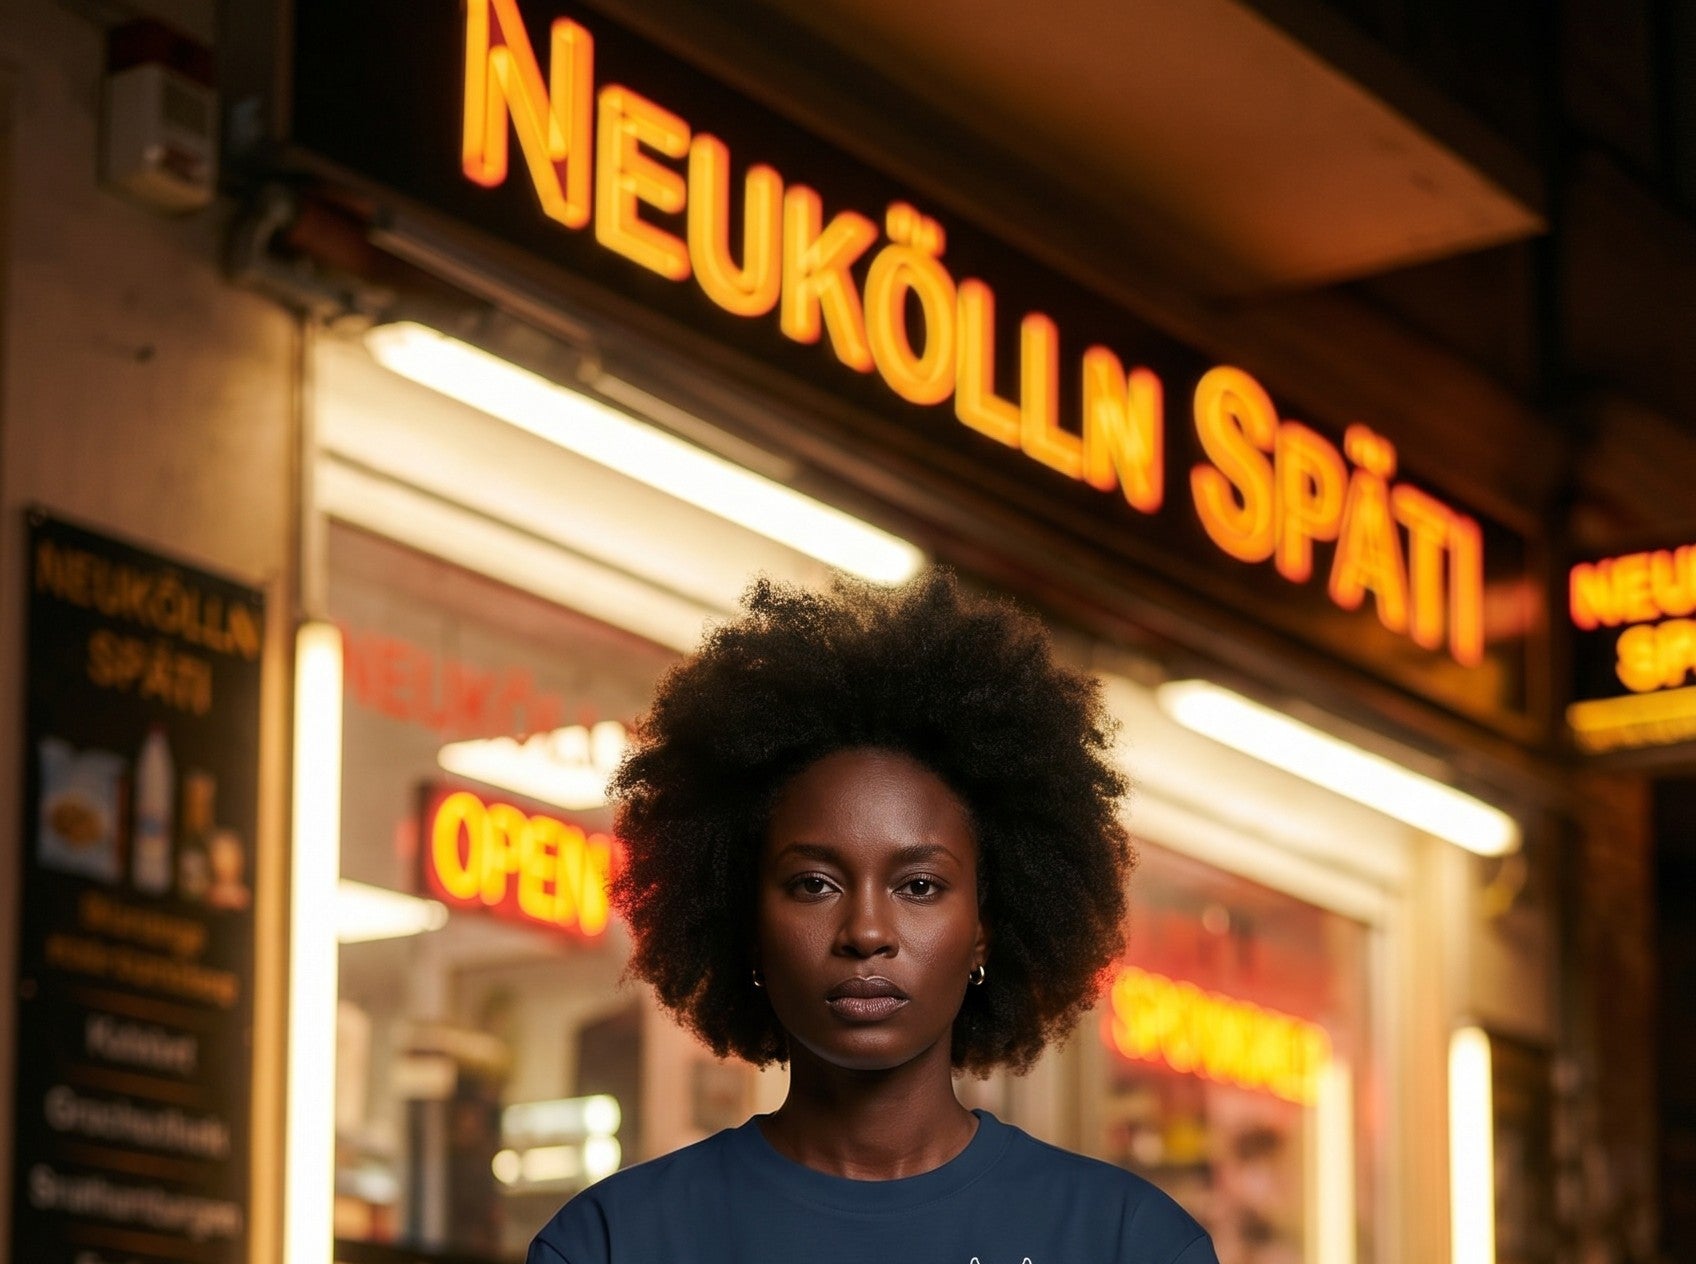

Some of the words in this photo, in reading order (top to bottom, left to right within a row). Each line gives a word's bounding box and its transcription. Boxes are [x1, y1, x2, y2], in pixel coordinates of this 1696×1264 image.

[462, 0, 1164, 514] NEUKÖLLN
[1190, 365, 1485, 669] SPÄTI
[1569, 544, 1696, 632] NEU
[1615, 617, 1696, 693] SP
[431, 791, 613, 937] OPEN
